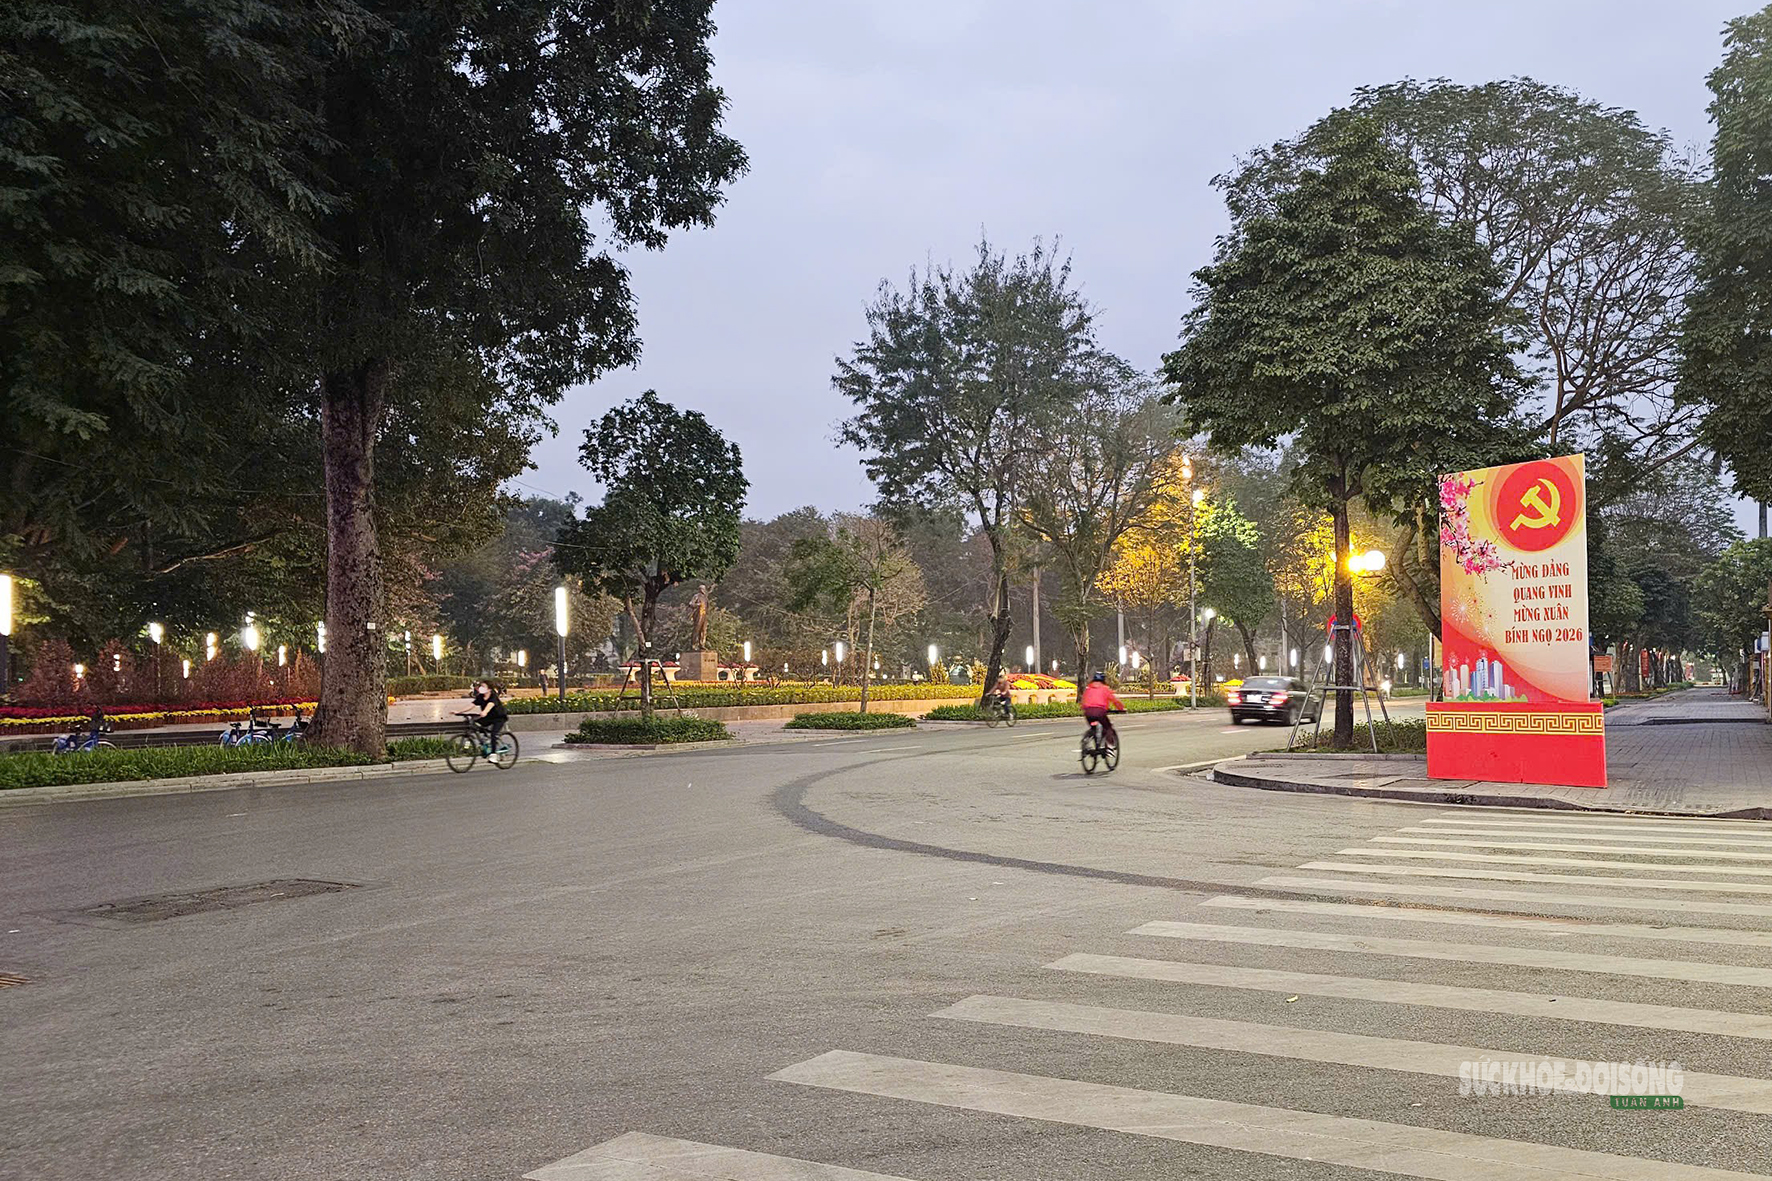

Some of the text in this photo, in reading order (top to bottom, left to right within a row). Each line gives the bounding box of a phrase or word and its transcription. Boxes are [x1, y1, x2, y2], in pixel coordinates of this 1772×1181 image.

[1513, 584, 1572, 604] QUANG VINH
[1543, 602, 1570, 622] XUÂN
[1505, 625, 1583, 646] BÍNH NGỌ 2026
